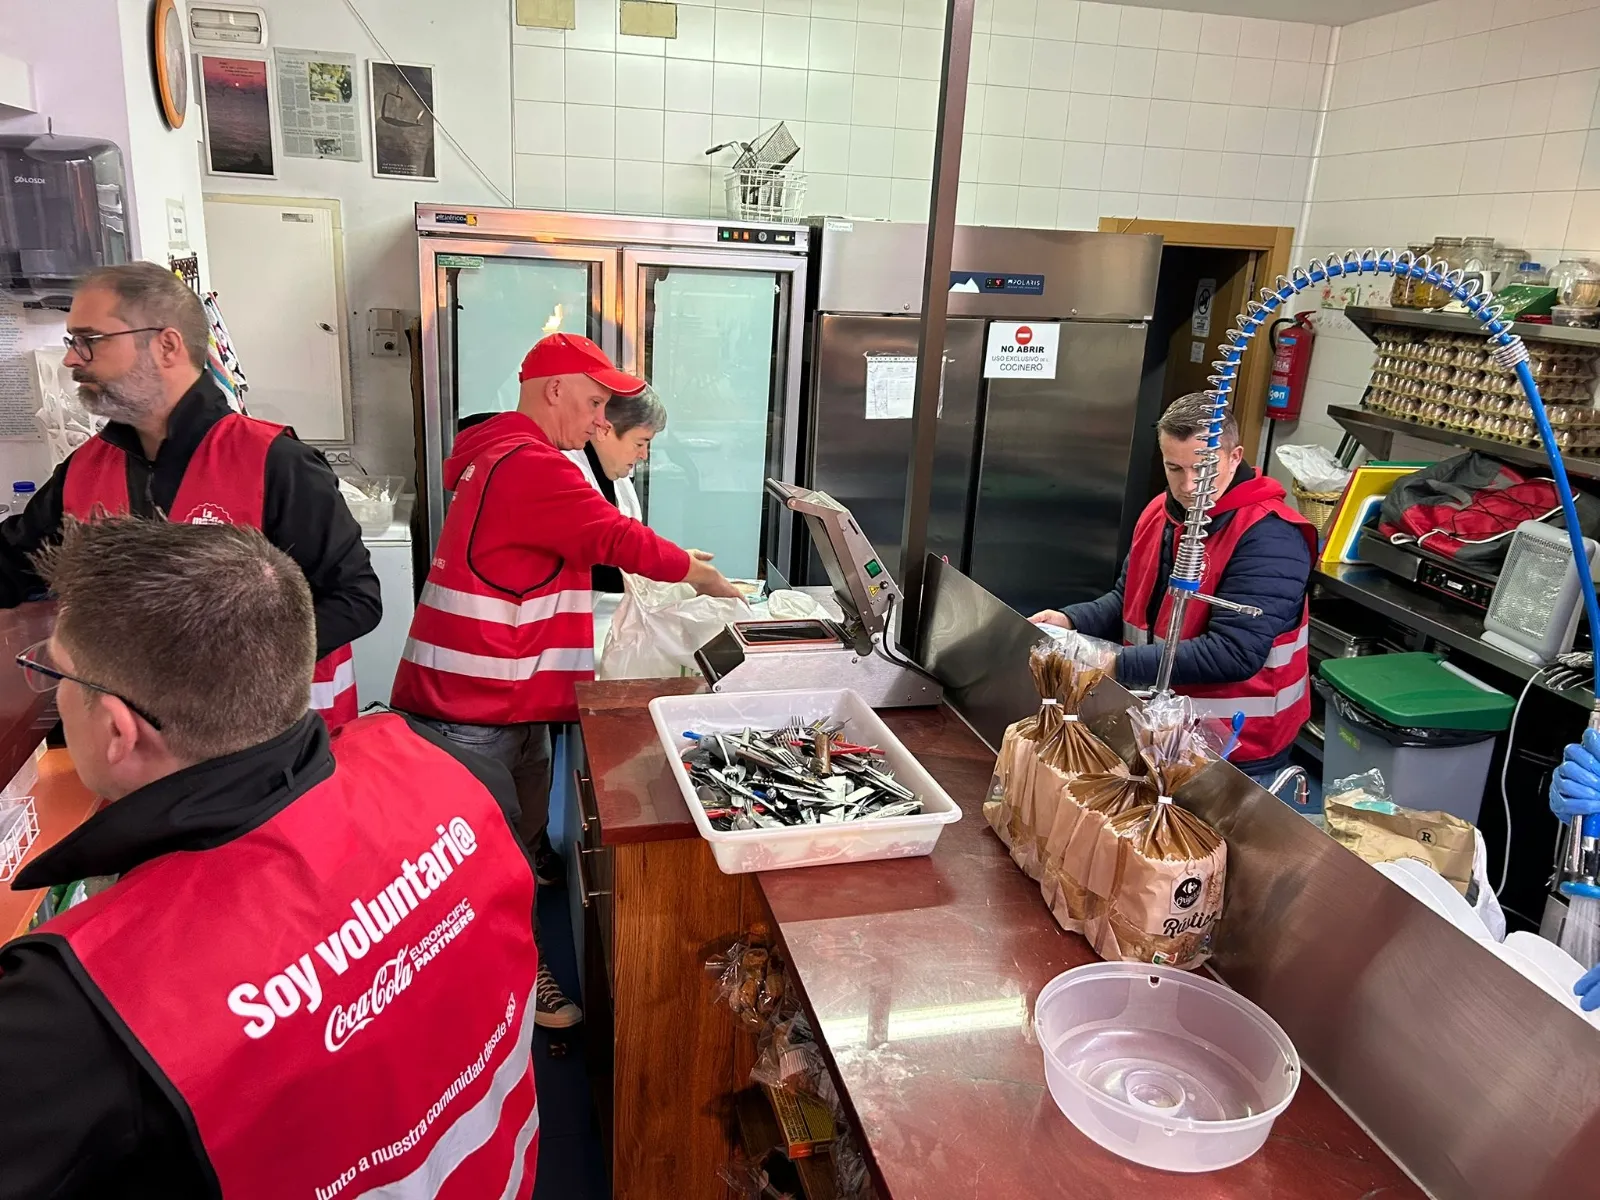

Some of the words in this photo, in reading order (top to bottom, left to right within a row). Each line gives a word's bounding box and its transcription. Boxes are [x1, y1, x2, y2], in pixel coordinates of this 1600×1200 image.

[999, 363, 1043, 371] COCINERO
[1001, 345, 1014, 353] NO
[1016, 345, 1045, 354] ABRIR
[1421, 831, 1433, 843] R
[227, 953, 323, 1040] Soy
[314, 816, 478, 976] voluntari@
[409, 897, 471, 961] EUROPACIFIC
[413, 908, 476, 972] PARTNERS
[358, 1156, 370, 1172] a
[371, 1119, 428, 1166] nuestra
[426, 1052, 485, 1125] comunidad
[483, 1021, 507, 1063] desde
